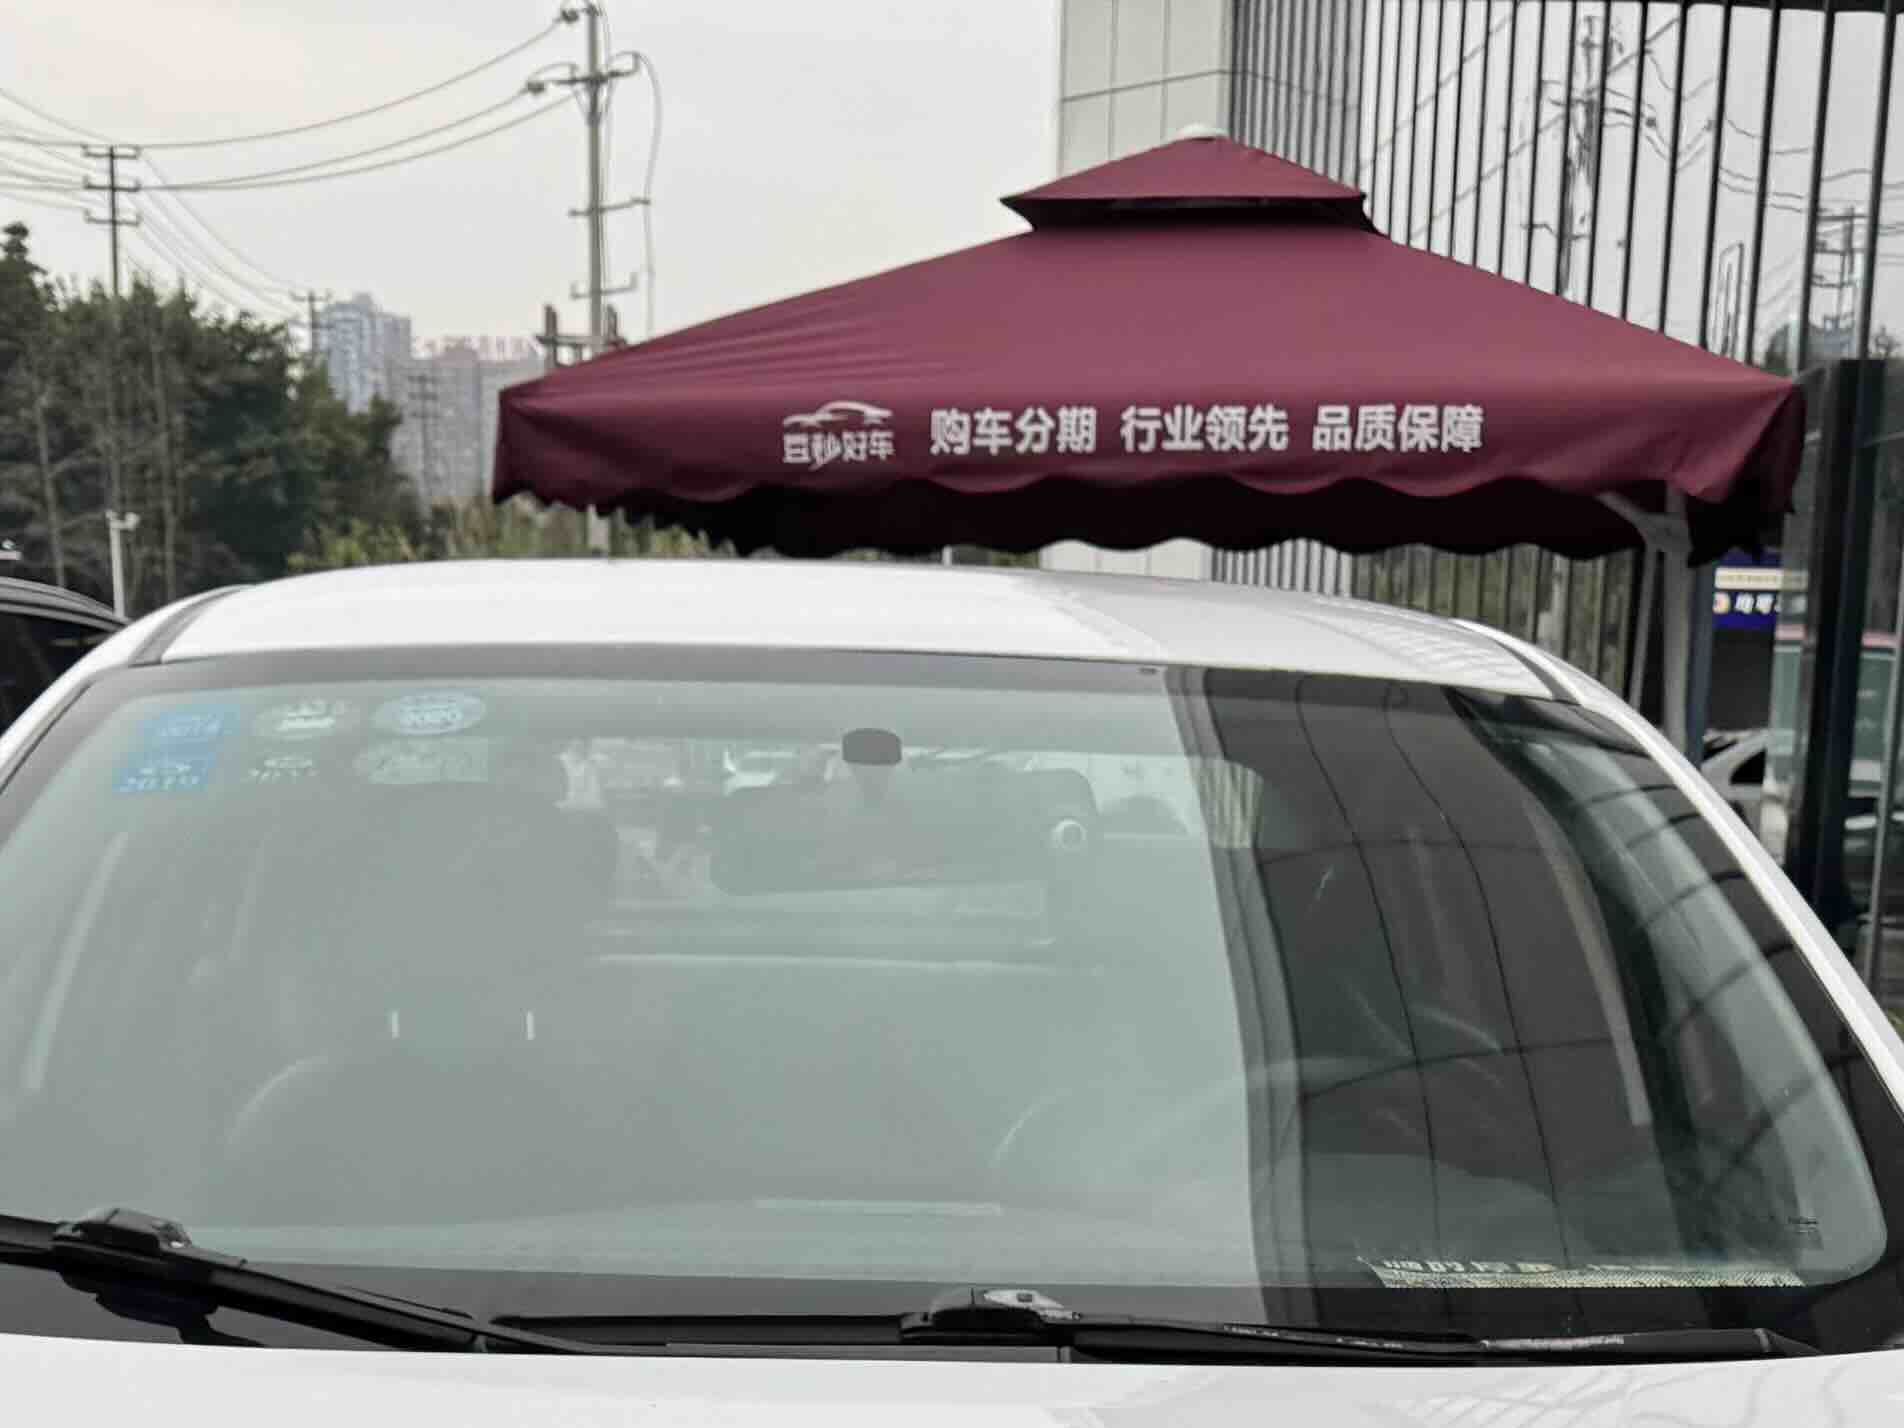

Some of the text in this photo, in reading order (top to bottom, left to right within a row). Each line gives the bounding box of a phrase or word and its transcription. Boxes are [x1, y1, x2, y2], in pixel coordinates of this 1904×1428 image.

[930, 404, 1485, 456] 购车分期 行业领先 品质保障
